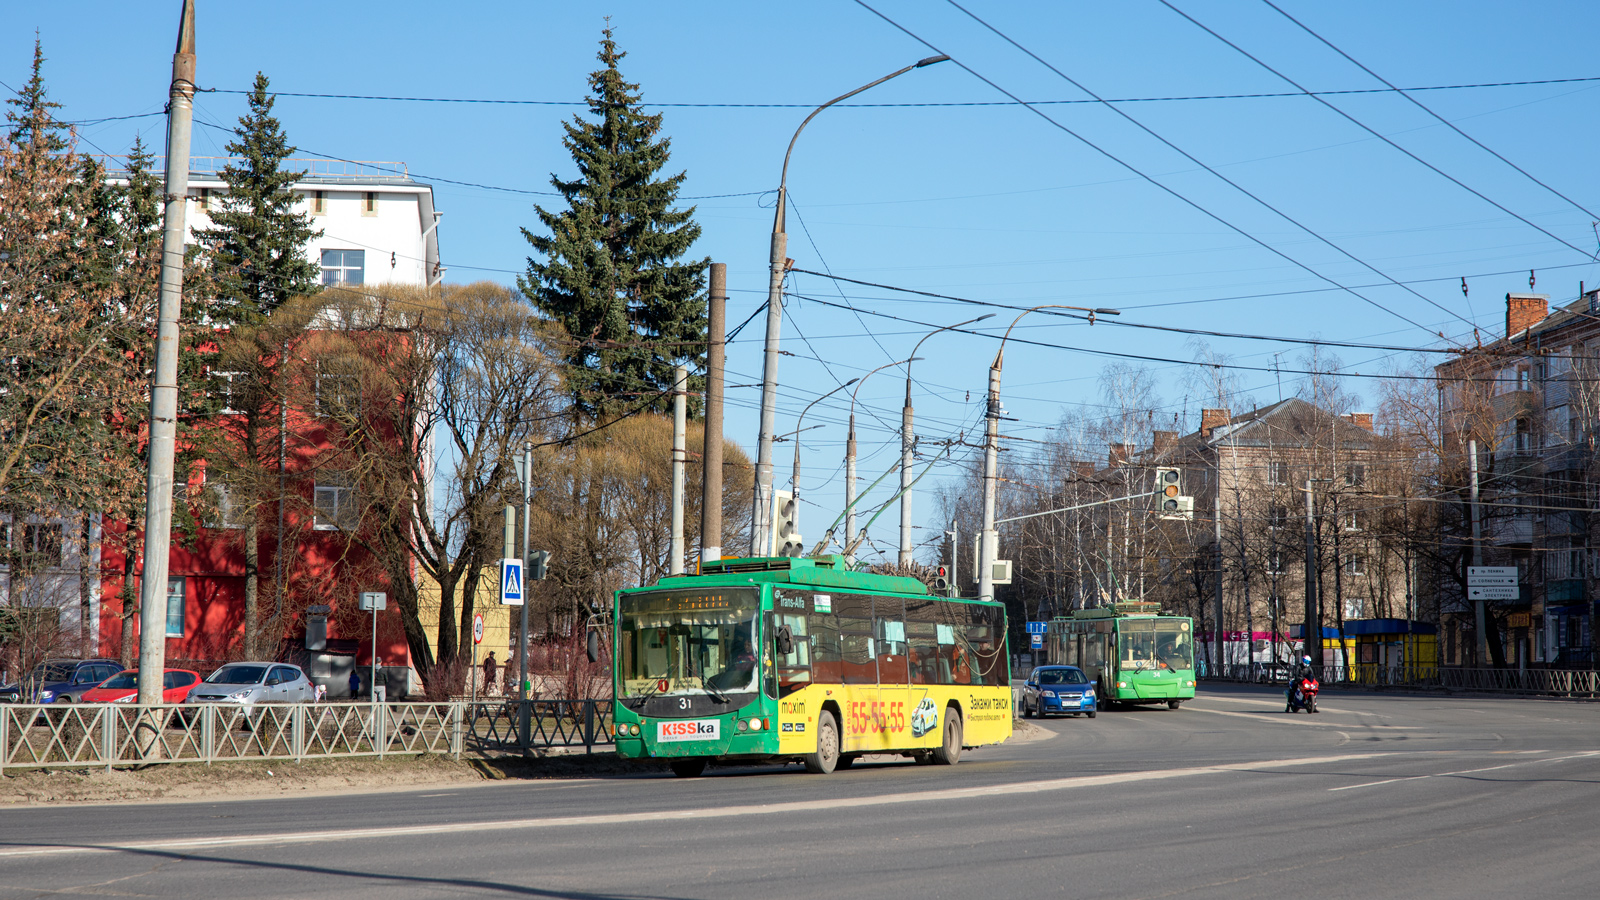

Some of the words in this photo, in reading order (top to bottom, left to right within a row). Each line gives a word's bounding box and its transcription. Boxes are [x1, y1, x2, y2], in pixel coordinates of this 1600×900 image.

[780, 595, 805, 609] Trans-Alfa
[476, 623, 482, 634] 40
[679, 697, 692, 710] 31
[782, 698, 806, 714] maxim
[970, 694, 991, 710] Закажи
[992, 698, 1008, 710] такси
